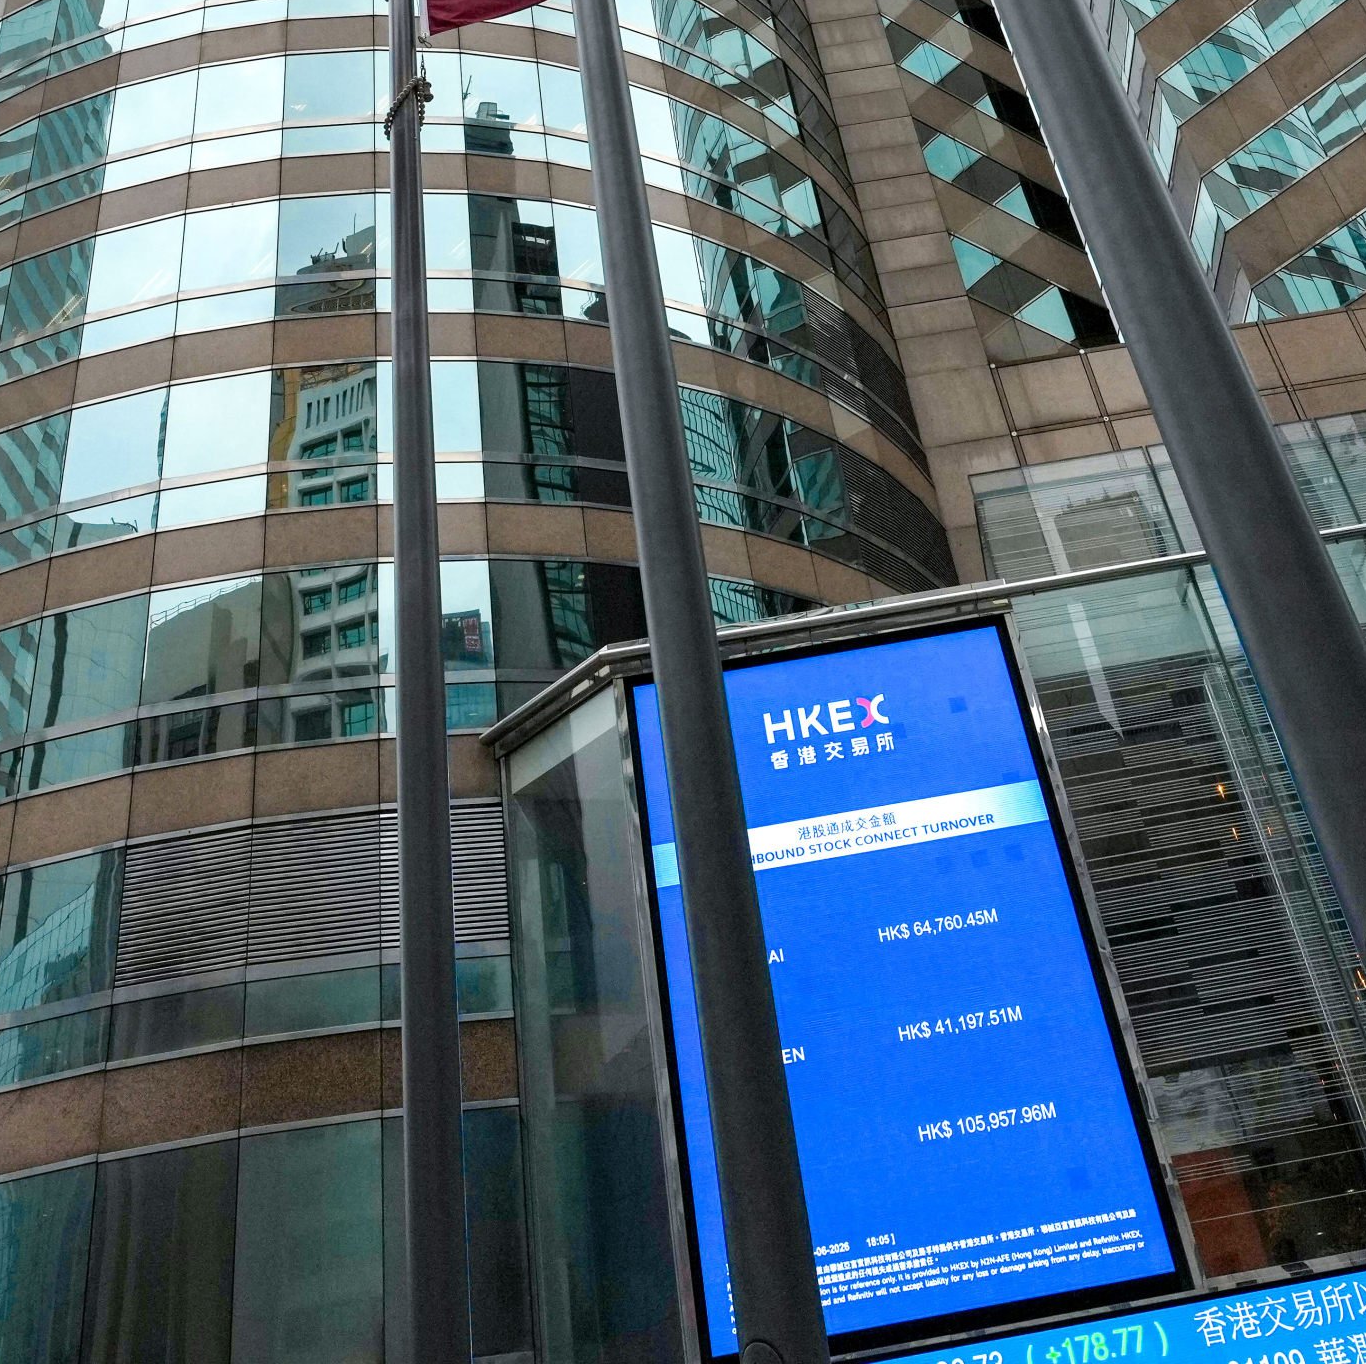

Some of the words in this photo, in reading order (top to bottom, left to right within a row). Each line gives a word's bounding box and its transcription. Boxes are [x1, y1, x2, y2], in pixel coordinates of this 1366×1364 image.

[763, 694, 889, 744] HKEX
[771, 732, 894, 769] 香港交易所
[798, 813, 896, 840] 港股通成交金額
[809, 839, 851, 854] STOCK
[856, 827, 917, 845] CONNECT
[922, 814, 995, 834] TURNOVER
[878, 923, 910, 942] HK$
[913, 908, 998, 937] 64,760.45M
[898, 1021, 931, 1041] HK$
[935, 1006, 1023, 1035] 41,197.51M
[918, 1121, 952, 1142] HK$
[956, 1102, 1057, 1136] 105,957.96M
[833, 1295, 845, 1304] and
[1051, 1256, 1067, 1264] from
[850, 1279, 880, 1290] reference
[950, 1262, 969, 1271] HKEX
[1054, 1241, 1078, 1252] Limited
[1080, 1239, 1092, 1248] and
